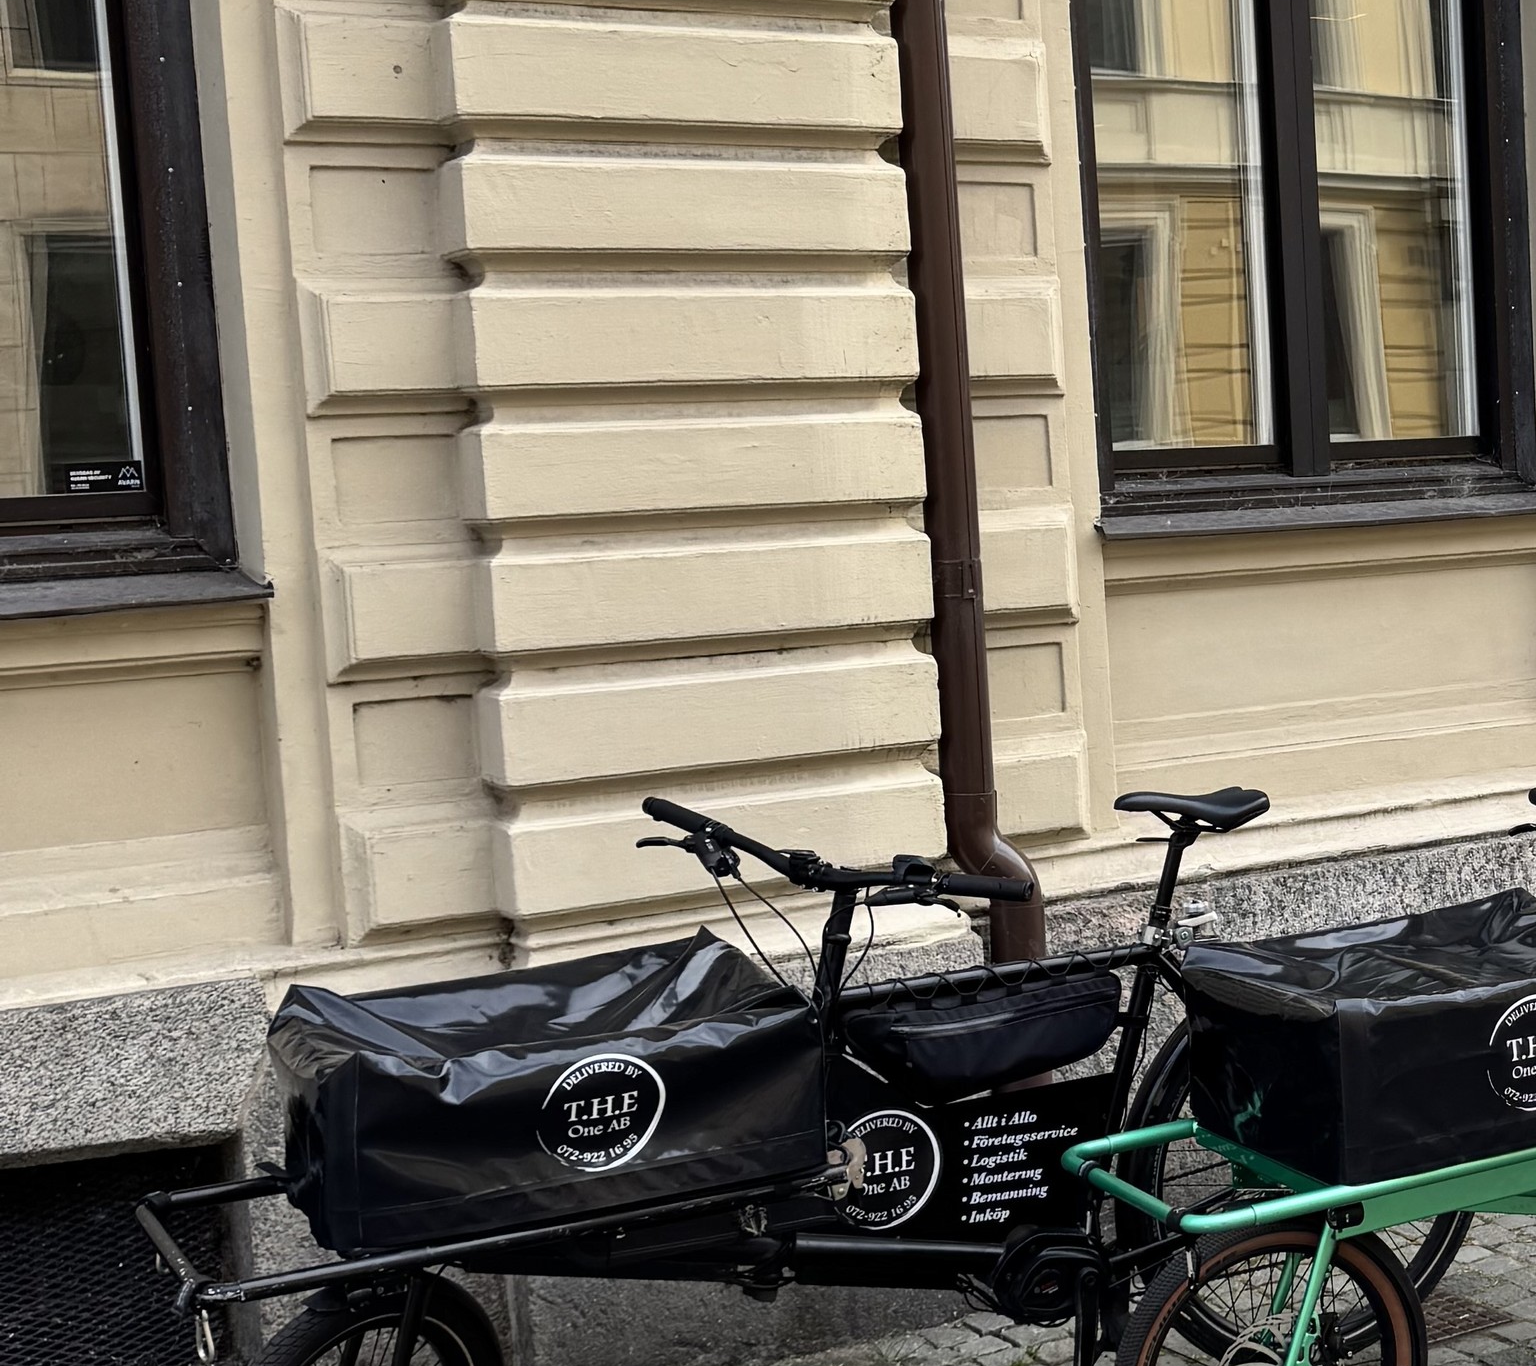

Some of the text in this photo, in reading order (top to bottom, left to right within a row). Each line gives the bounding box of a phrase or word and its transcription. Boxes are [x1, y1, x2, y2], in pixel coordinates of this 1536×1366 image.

[562, 1062, 642, 1090] DELIVERED BY
[564, 1091, 638, 1122] T.H.E
[568, 1116, 630, 1137] One AB
[854, 1117, 917, 1137] ELIVERED BY
[971, 1111, 1037, 1129] Allt i Allo
[971, 1125, 1078, 1148] Företagsservice
[557, 1133, 638, 1162] 072-922 16 95
[864, 1147, 915, 1176] .H.E
[971, 1149, 1028, 1168] Logistik
[890, 1176, 910, 1191] AB
[970, 1168, 1043, 1186] Montering
[969, 1184, 1048, 1204] Bemanning
[846, 1195, 916, 1221] 072-922 16 95
[969, 1208, 1010, 1223] Inköp
